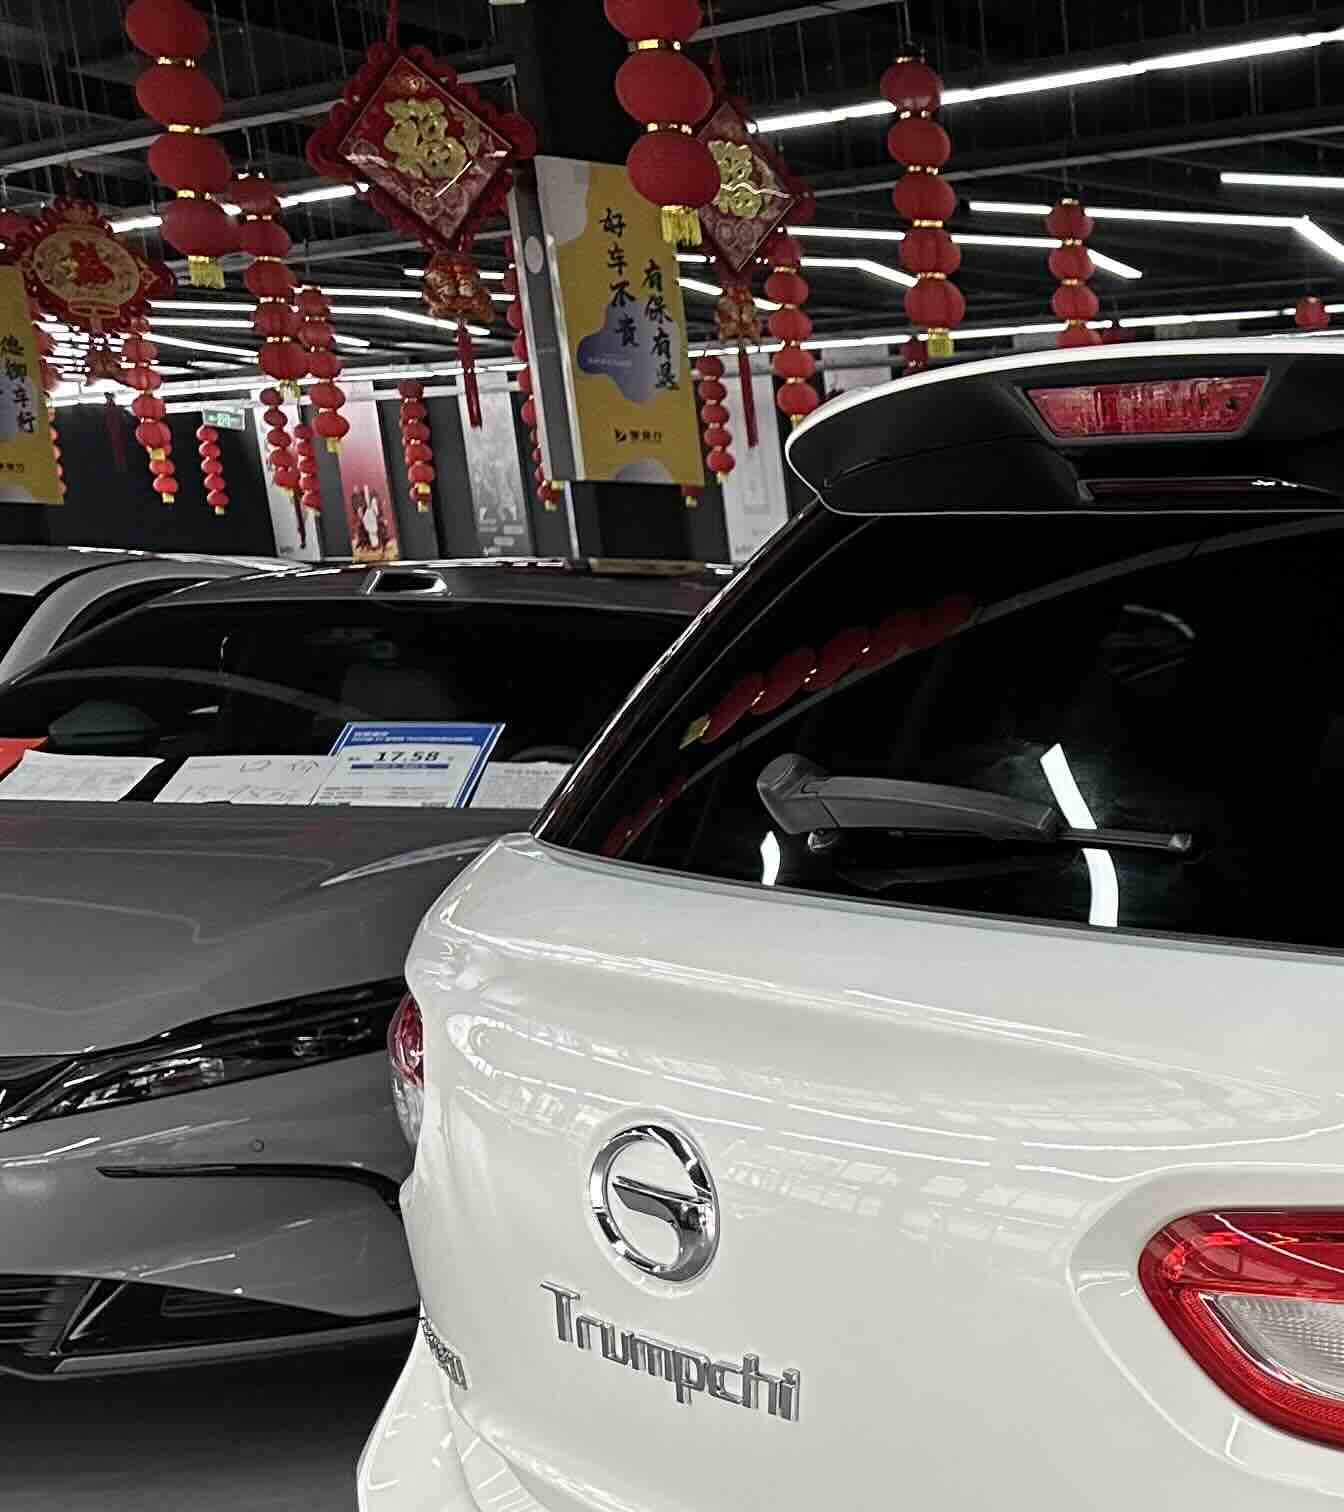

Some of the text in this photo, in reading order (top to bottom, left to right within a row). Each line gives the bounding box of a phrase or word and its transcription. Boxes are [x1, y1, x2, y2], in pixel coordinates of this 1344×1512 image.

[599, 207, 640, 348] 好车不贵
[373, 751, 442, 762] 17.58
[540, 1279, 803, 1423] Trumpchi
